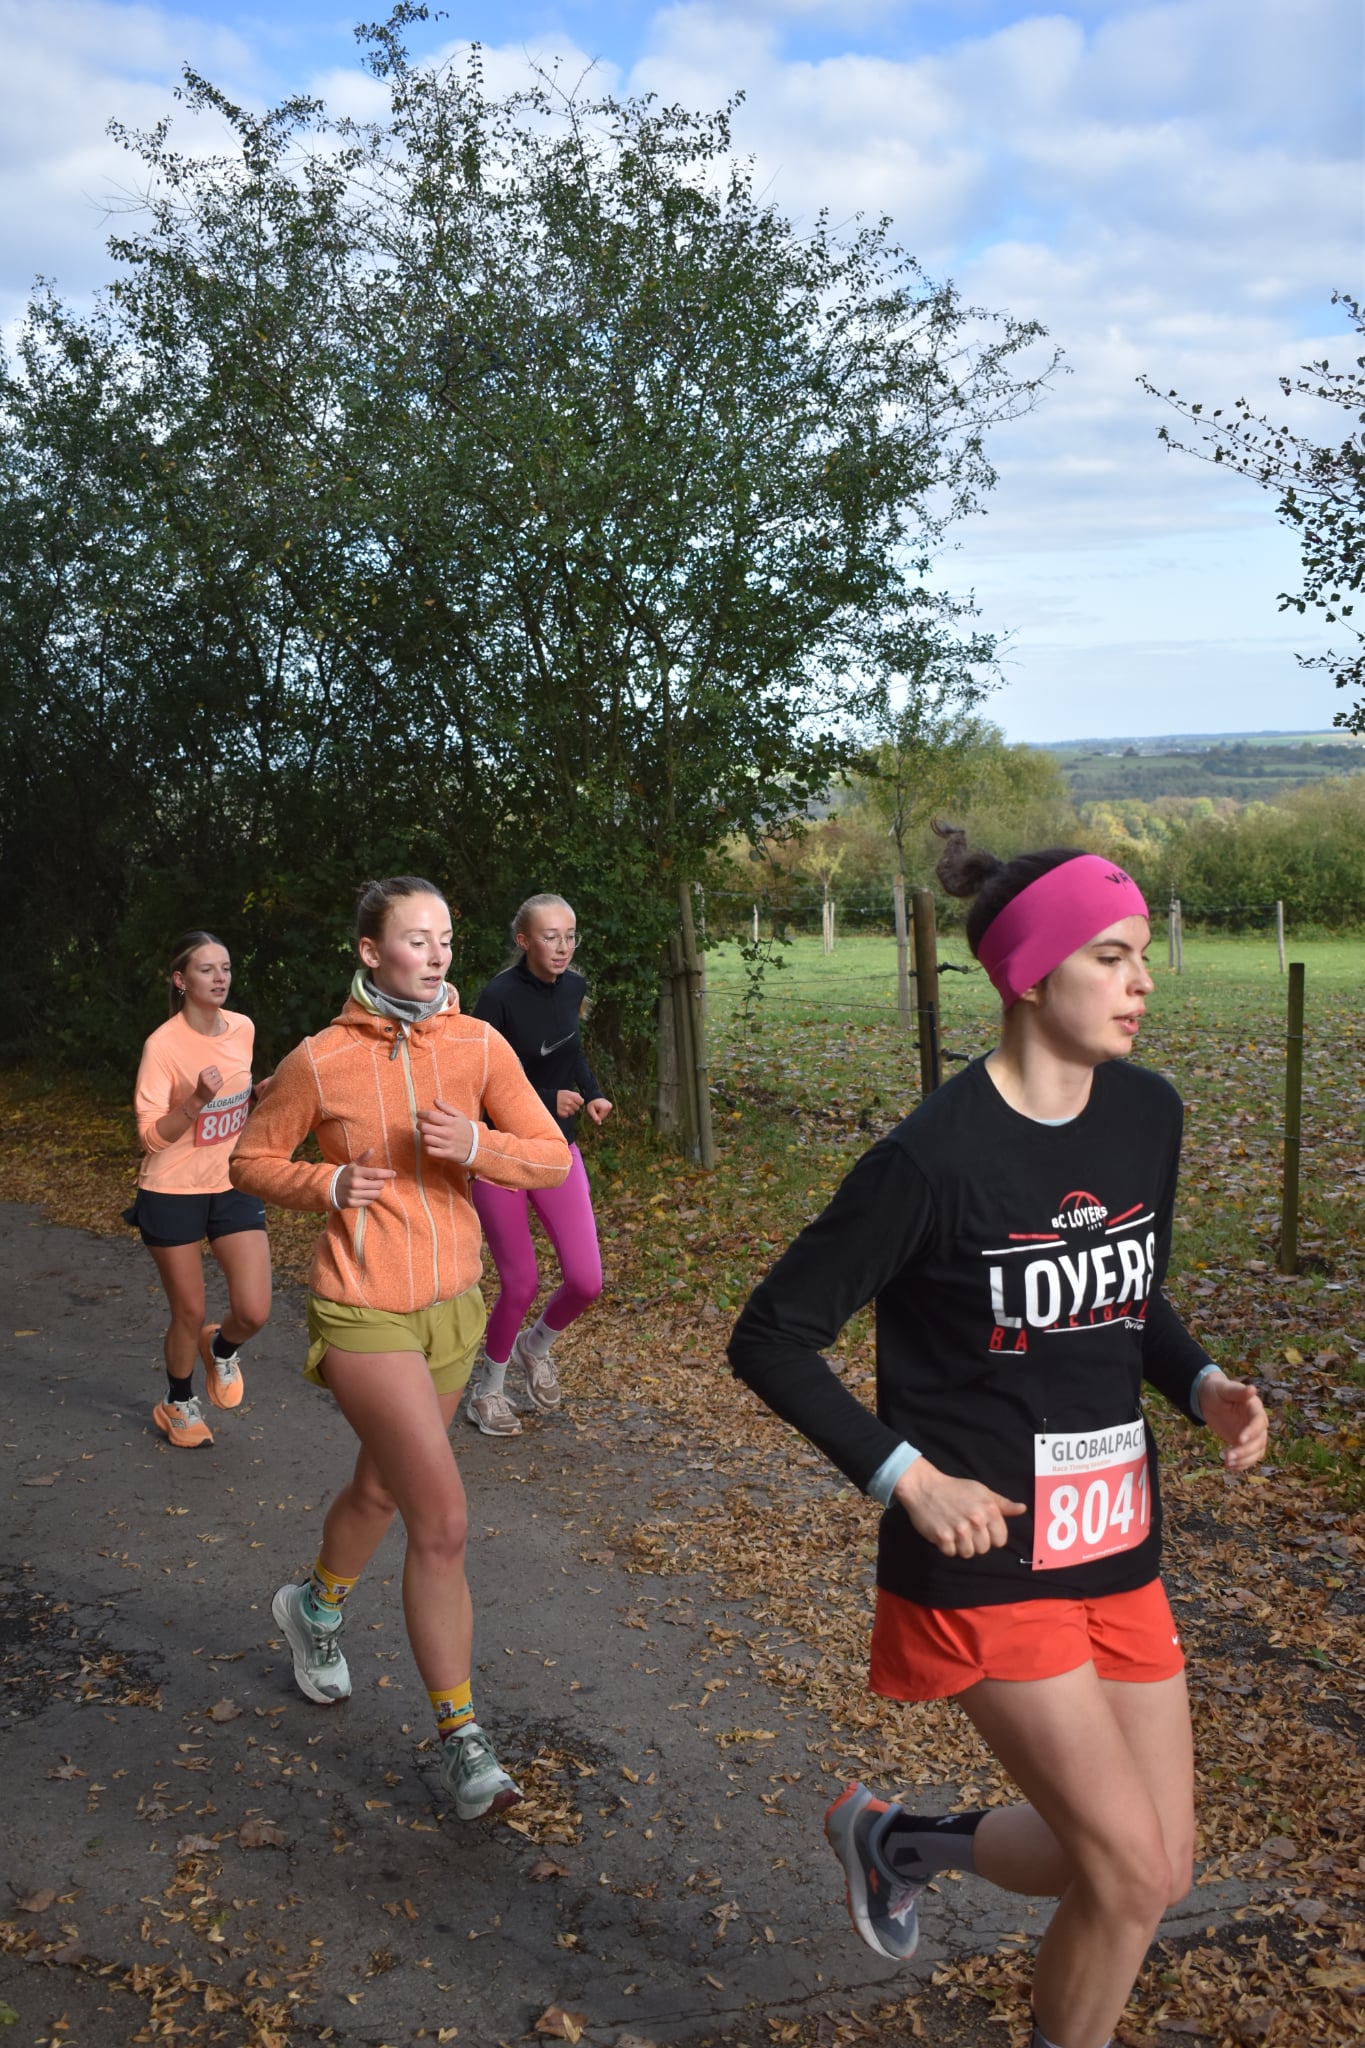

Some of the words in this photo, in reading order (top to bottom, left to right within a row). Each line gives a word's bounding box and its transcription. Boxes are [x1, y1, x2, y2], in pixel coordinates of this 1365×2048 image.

[1051, 1213, 1068, 1229] BC
[1068, 1206, 1108, 1228] LOYERS
[1047, 1463, 1147, 1550] 8041
